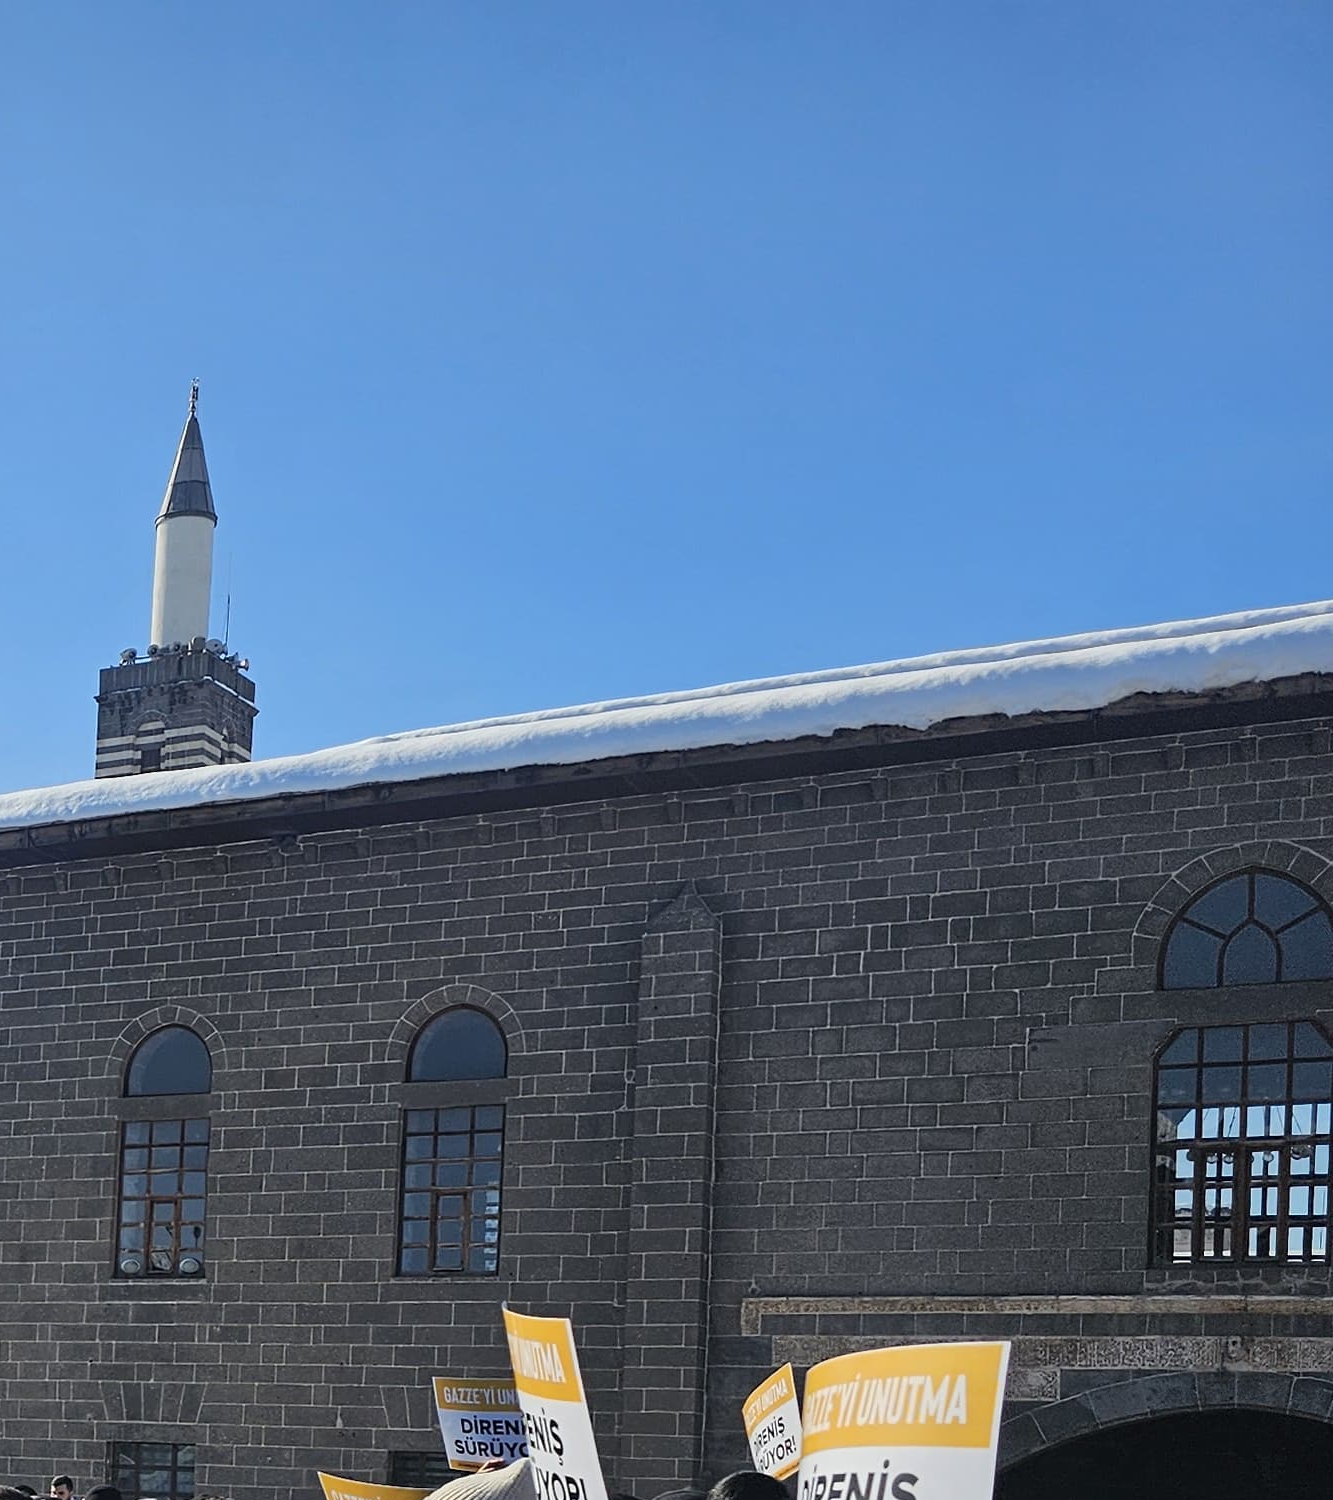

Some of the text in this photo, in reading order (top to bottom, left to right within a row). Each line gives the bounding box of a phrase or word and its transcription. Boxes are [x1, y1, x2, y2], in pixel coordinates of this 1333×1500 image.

[443, 1385, 495, 1405] GAZZE'Yİ
[858, 1374, 968, 1426] UNUTMA
[525, 1407, 564, 1466] ENİŞ
